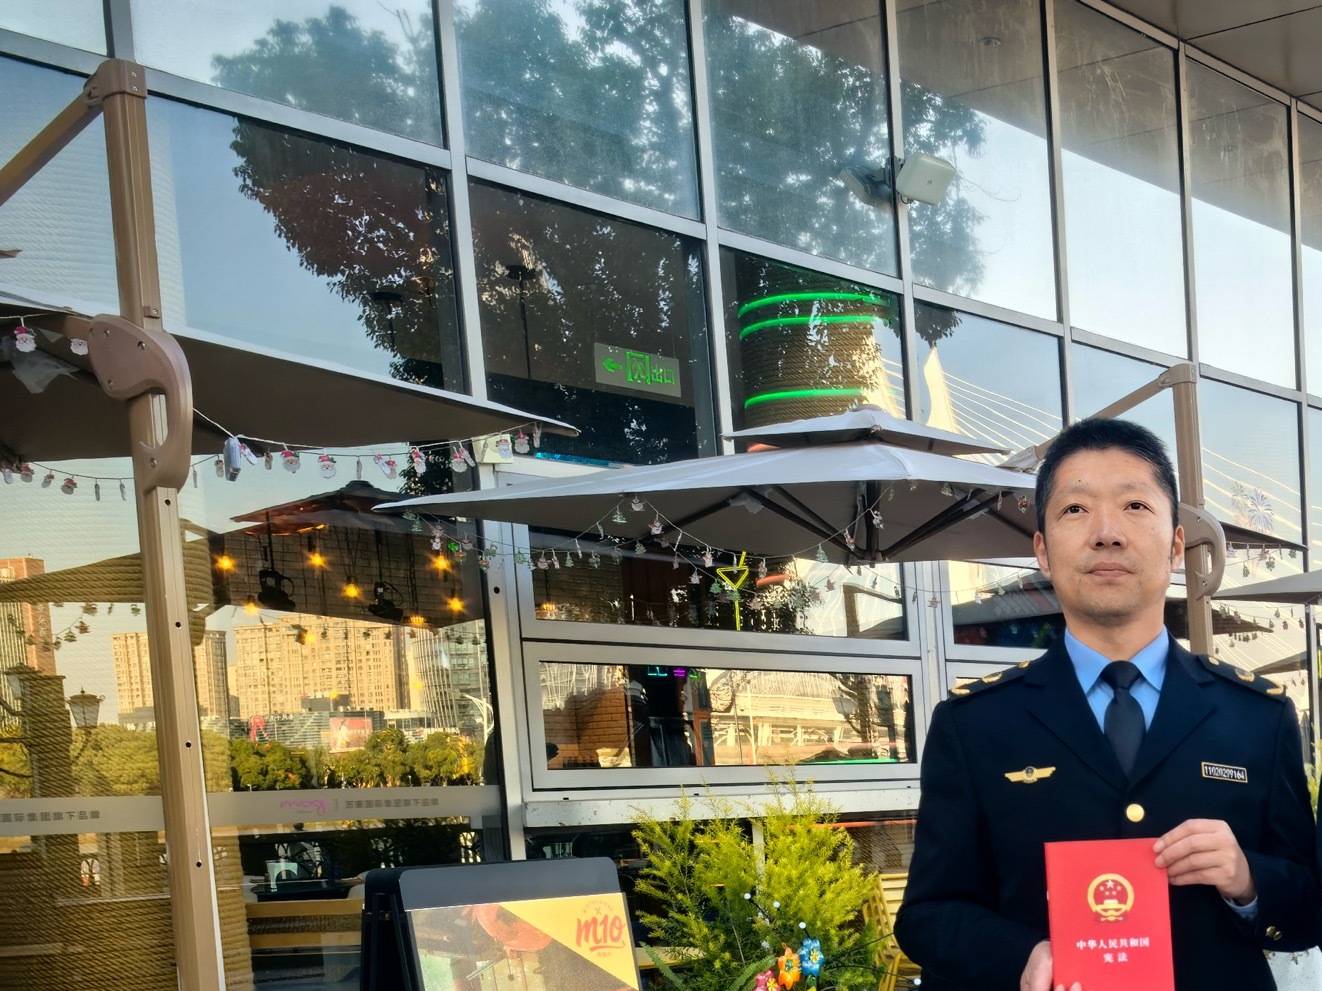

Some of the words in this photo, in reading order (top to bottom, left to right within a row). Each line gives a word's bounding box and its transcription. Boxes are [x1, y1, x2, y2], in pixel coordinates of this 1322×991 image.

[651, 363, 676, 385] 出口
[1076, 937, 1150, 950] 中华人民共和国
